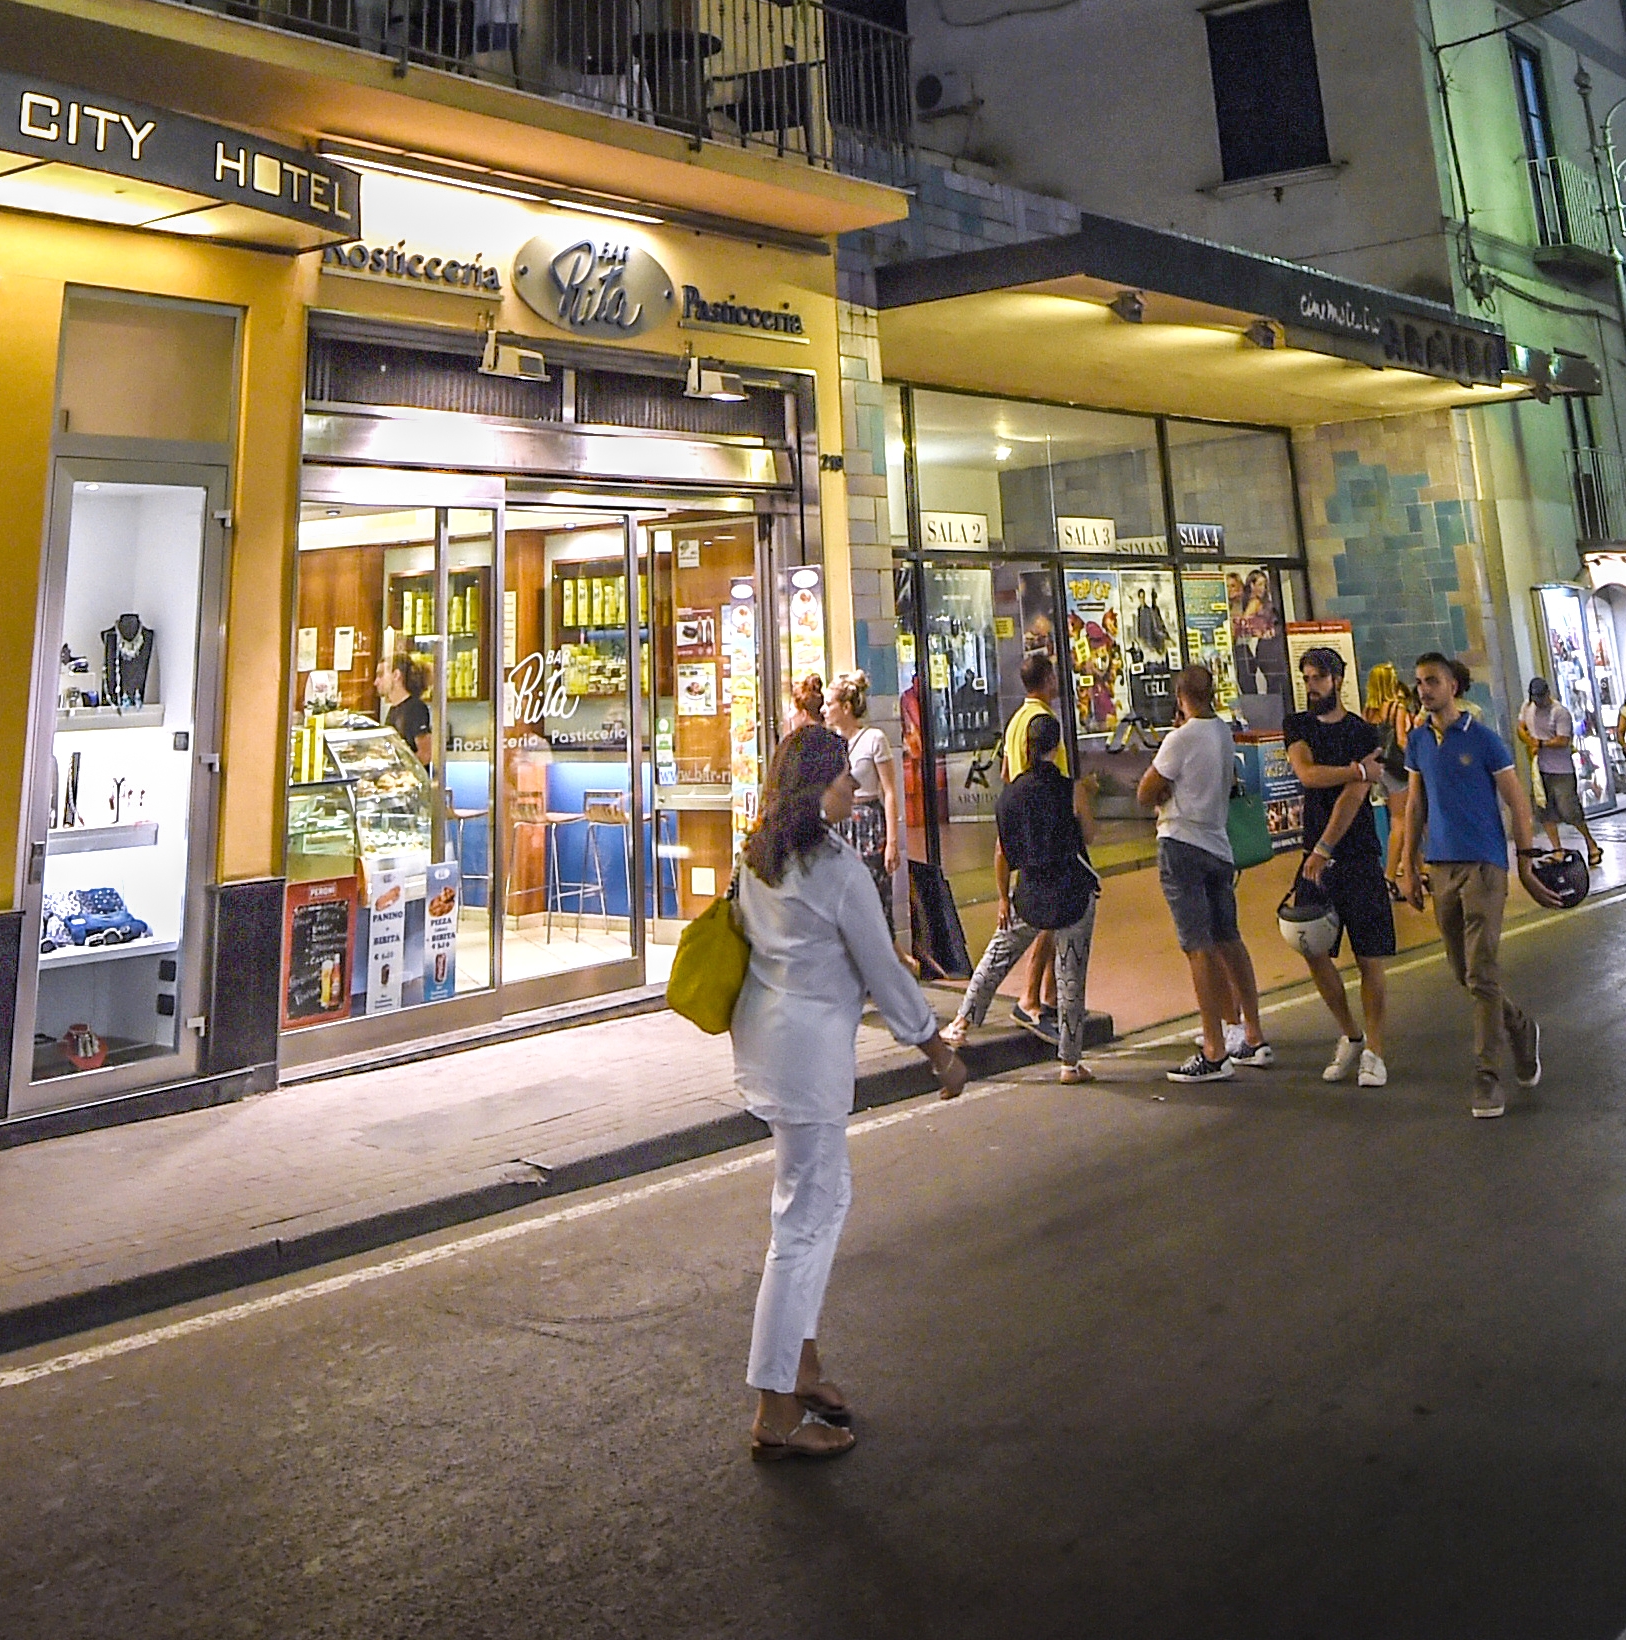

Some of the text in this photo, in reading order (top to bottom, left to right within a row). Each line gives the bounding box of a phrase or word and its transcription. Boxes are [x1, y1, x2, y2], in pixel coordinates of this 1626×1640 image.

[19, 90, 156, 161] CITY
[214, 140, 353, 222] HOTEL
[548, 239, 643, 329] Rita
[681, 284, 803, 335] Pasticceria
[927, 520, 983, 544] SALA 2
[1064, 525, 1111, 546] SALA 3
[1179, 526, 1210, 546] SALA
[1068, 578, 1111, 600] TOP CAT
[545, 649, 571, 665] BAR
[508, 651, 580, 725] Rita
[453, 732, 538, 752] Rostceria
[372, 911, 403, 923] PANINO
[430, 917, 452, 927] PIZZA
[374, 934, 400, 946] BIBITA
[432, 932, 456, 942] BIBITA
